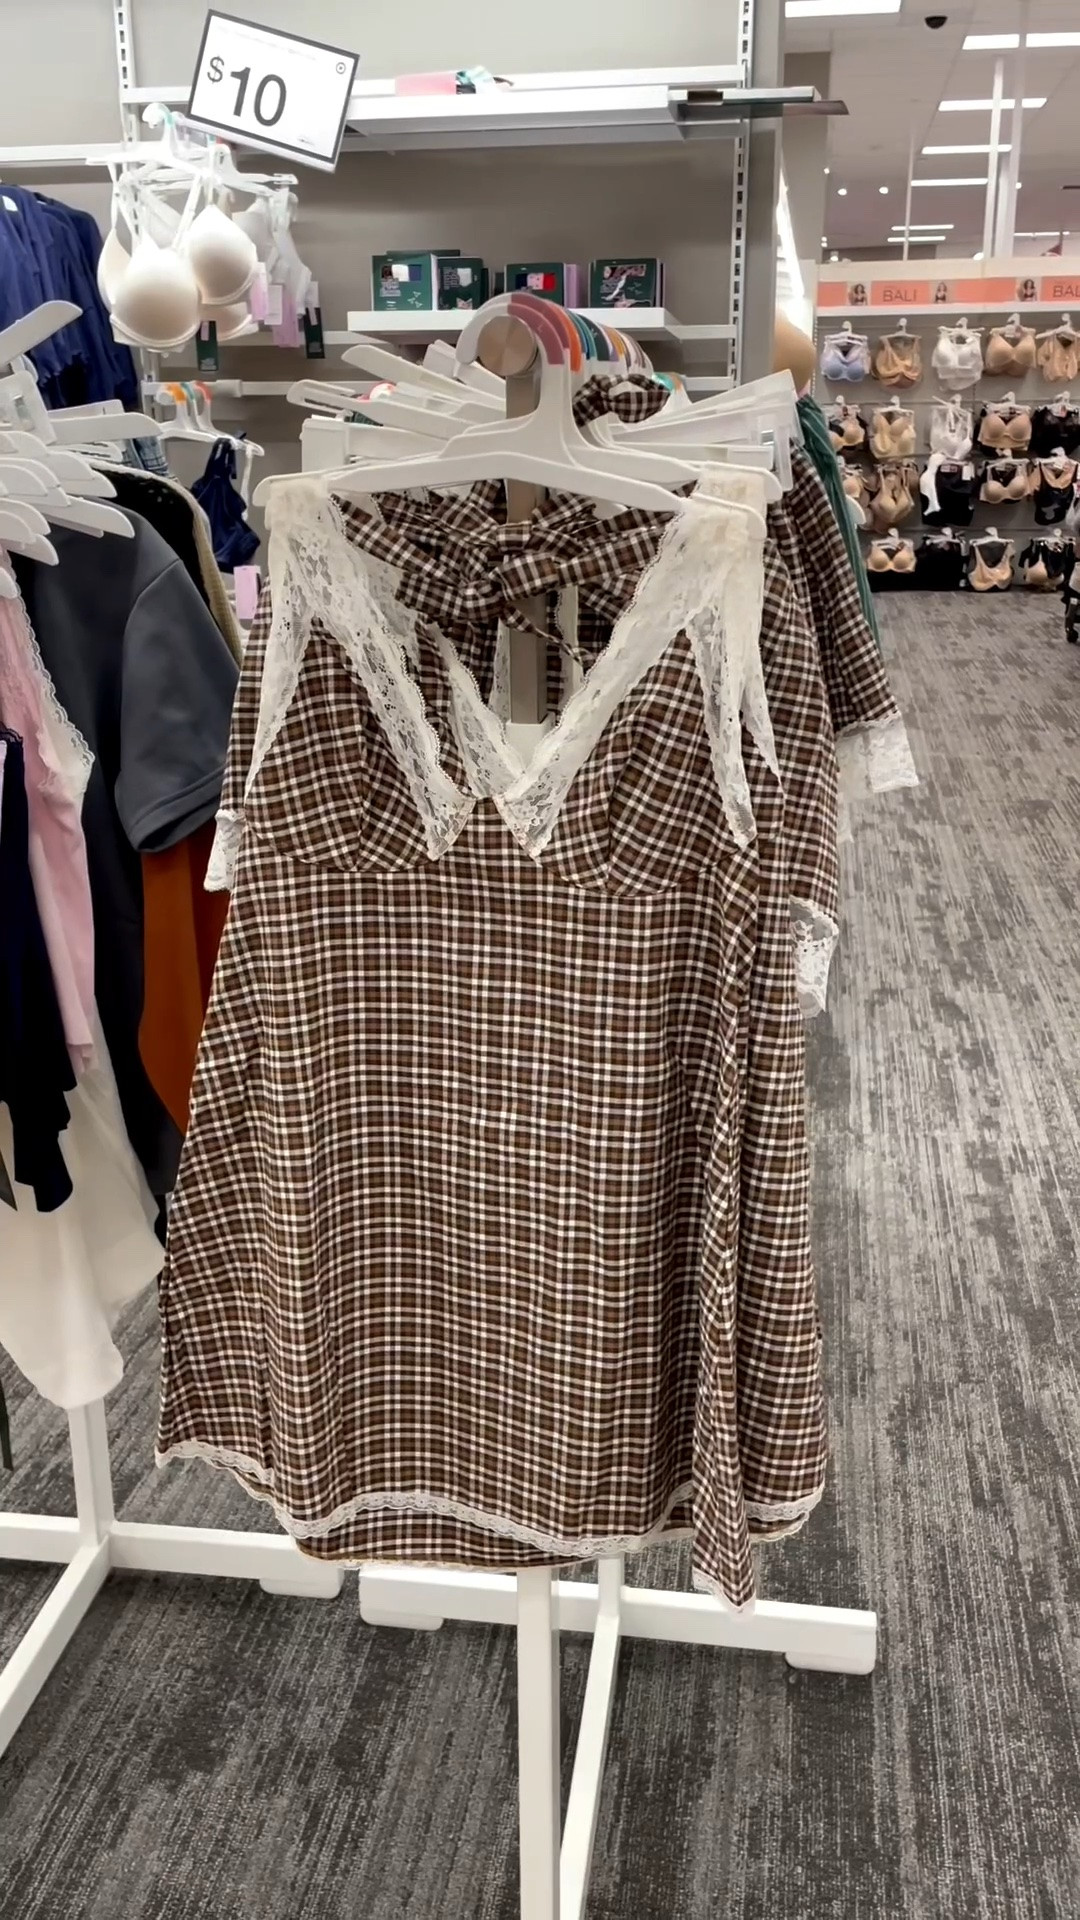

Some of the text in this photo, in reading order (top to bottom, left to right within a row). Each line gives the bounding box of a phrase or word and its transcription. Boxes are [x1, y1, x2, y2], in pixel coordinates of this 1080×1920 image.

[207, 56, 287, 127] $10
[882, 289, 917, 302] BALI
[1053, 284, 1080, 298] BAL
